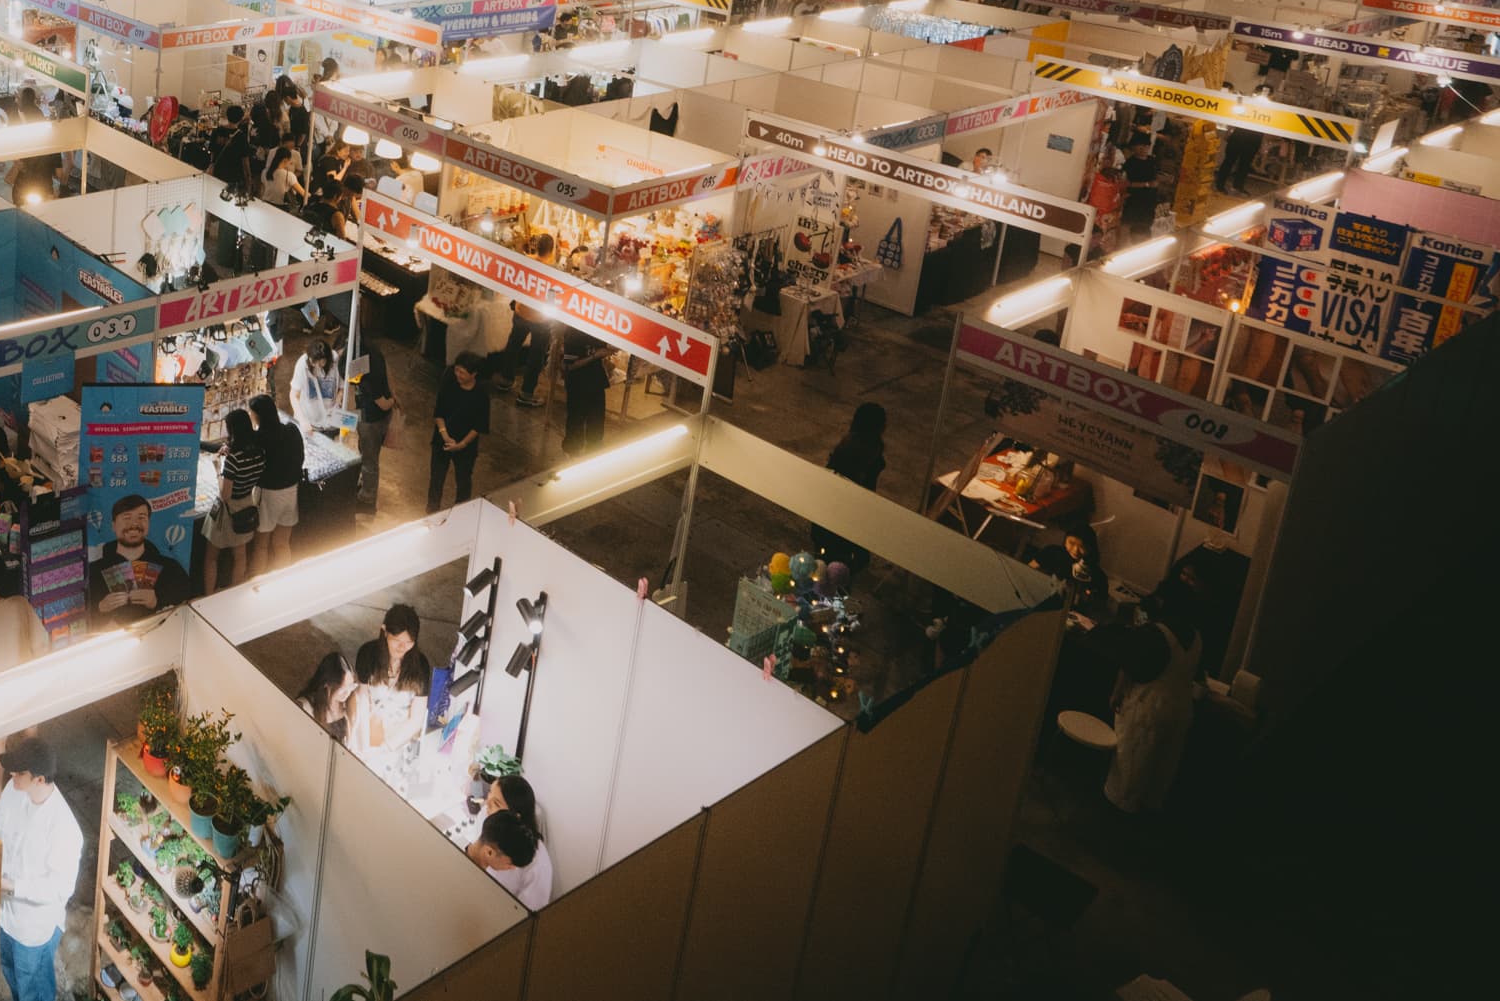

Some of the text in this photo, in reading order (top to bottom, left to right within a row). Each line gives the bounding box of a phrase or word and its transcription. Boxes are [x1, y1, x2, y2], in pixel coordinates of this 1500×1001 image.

[88, 11, 126, 36] ARTBOX
[1392, 1, 1470, 19] TAG US IG
[176, 28, 230, 46] ARTBOX
[1260, 27, 1470, 72] 15m HEAD TO AVENUE
[25, 53, 58, 78] MARKET
[1136, 85, 1219, 112] HEADROOM
[330, 96, 419, 142] ARTBOX 050
[956, 110, 996, 131] ARTBOX
[463, 142, 539, 188] ARTBOX
[775, 131, 1046, 220] 40m HEAD TO ARTBOX HAILAND
[628, 179, 689, 211] ARTBOX
[1273, 199, 1328, 221] Konica
[1421, 236, 1484, 260] Konica
[80, 270, 124, 304] FEASTABLES
[417, 226, 452, 256] TWO
[456, 241, 493, 276] WAY
[568, 291, 632, 334] AHEAD
[185, 273, 294, 323] ARTBOX
[1321, 291, 1381, 342] VISA
[995, 339, 1145, 414] ARTBOX
[140, 404, 189, 414] FEASTABLES
